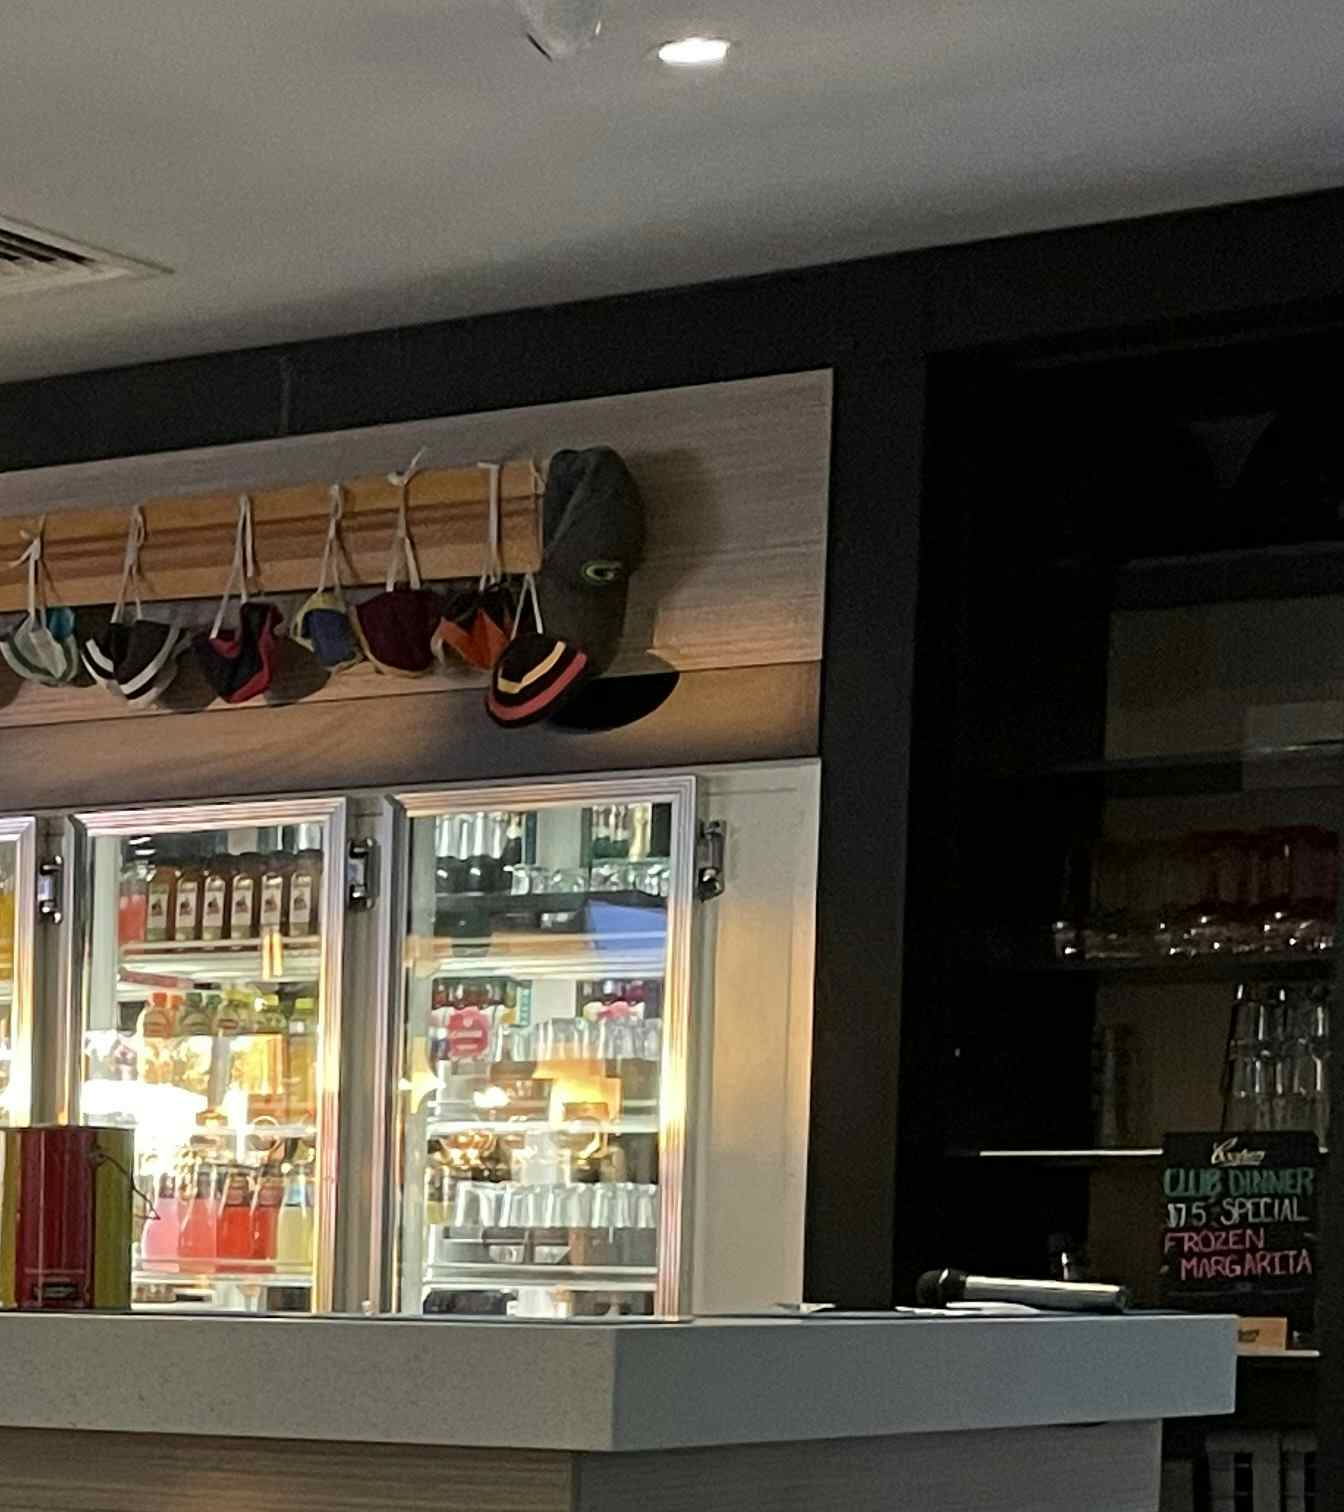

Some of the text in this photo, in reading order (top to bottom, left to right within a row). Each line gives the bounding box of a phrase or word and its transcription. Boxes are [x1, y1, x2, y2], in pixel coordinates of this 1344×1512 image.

[1164, 1166, 1314, 1197] CLUB DINNER
[1220, 1197, 1310, 1225] SPECIAL
[1164, 1228, 1265, 1253] FROZEN
[1180, 1248, 1313, 1280] MARGARITA
